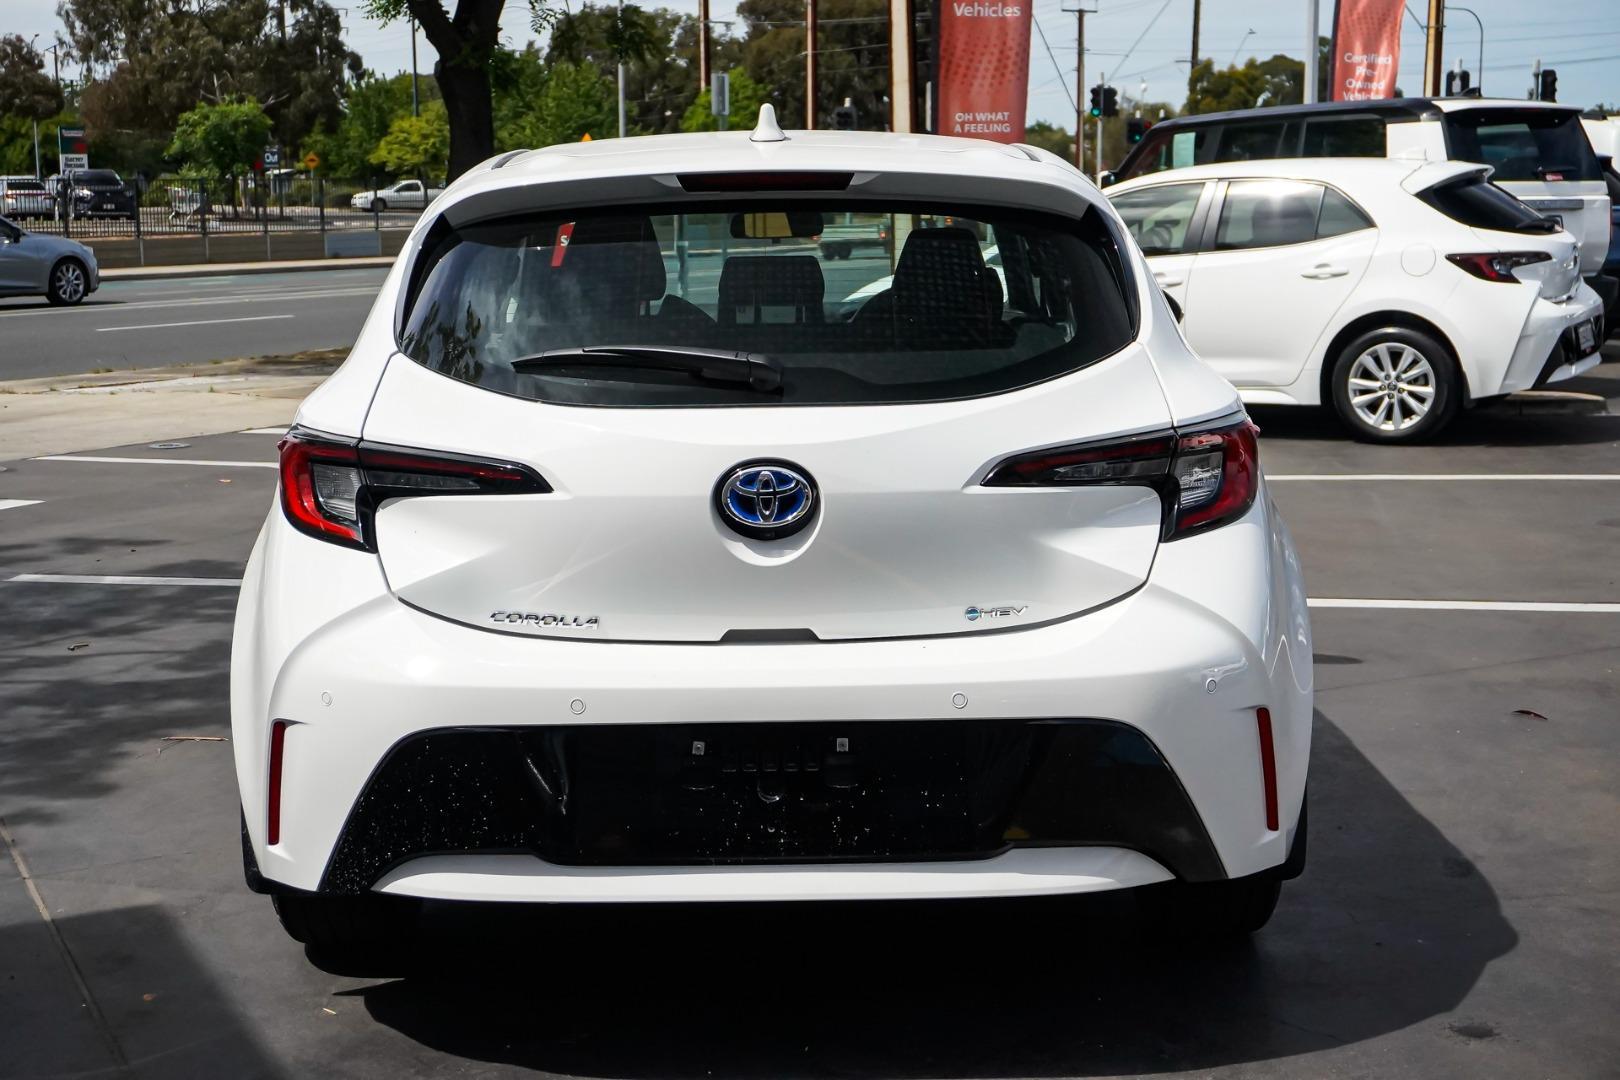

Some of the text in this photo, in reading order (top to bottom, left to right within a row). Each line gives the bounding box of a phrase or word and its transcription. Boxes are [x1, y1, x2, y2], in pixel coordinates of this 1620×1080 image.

[953, 2, 1021, 16] Vehicles
[1344, 53, 1392, 64] Certified
[1346, 79, 1385, 88] Owned
[955, 112, 1010, 121] OH WHAT
[954, 123, 1010, 133] A FEELING
[979, 606, 1029, 618] HEV
[490, 612, 600, 629] COROLLA
